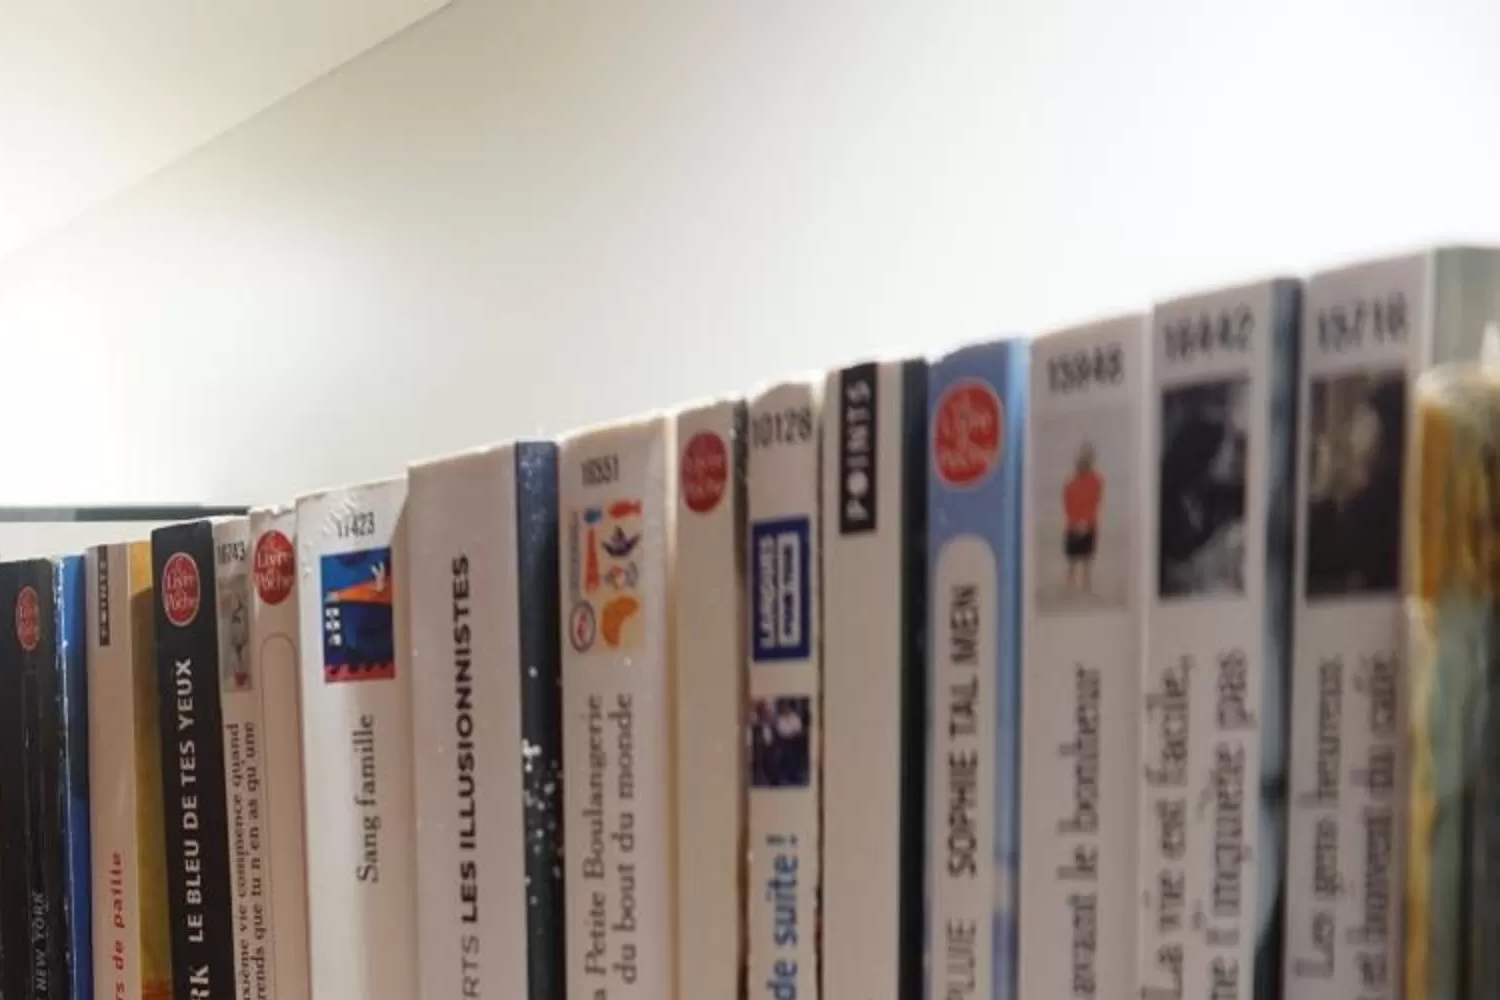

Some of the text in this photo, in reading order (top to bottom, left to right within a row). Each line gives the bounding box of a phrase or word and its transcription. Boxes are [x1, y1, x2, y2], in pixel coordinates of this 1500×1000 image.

[844, 379, 871, 522] POINTS
[226, 722, 244, 788] quand
[452, 555, 477, 923] LES ILLUSIONNISTES
[946, 583, 980, 879] SOPHIE TAL MEN
[1055, 666, 1101, 834] bonheur
[176, 658, 203, 943] LE BLEU DE TES YEUX
[248, 798, 258, 819] as
[352, 714, 381, 883] Sang famille
[581, 693, 606, 880] Boulangerie
[232, 793, 247, 898] commence
[607, 693, 637, 985] du bout du monde
[1055, 846, 1099, 882] le
[31, 888, 45, 944] YORK
[110, 851, 125, 929] paille
[236, 905, 248, 932] vie
[250, 878, 261, 897] tu
[253, 905, 267, 941] que
[35, 947, 46, 991] NEW
[112, 940, 122, 970] de
[583, 891, 606, 975] Petite
[1064, 894, 1099, 1000] avant
